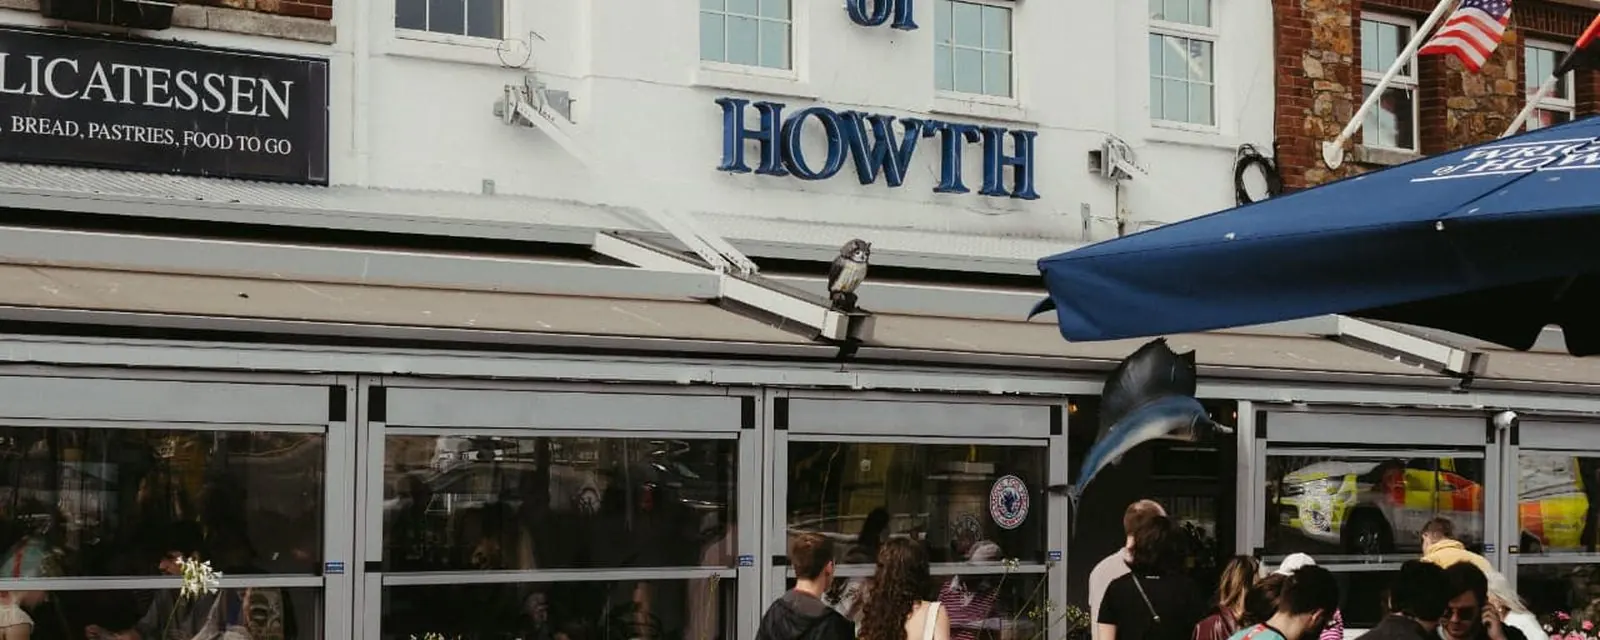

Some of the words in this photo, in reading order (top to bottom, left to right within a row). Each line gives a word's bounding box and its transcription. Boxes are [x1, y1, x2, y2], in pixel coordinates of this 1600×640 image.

[0, 53, 294, 119] LICATESSEN
[11, 116, 84, 139] BREAD,
[88, 122, 180, 147] PASTRIES,
[184, 131, 233, 150] FOOD
[236, 135, 261, 152] TO
[265, 138, 291, 155] GO
[715, 97, 1040, 200] HOWTH
